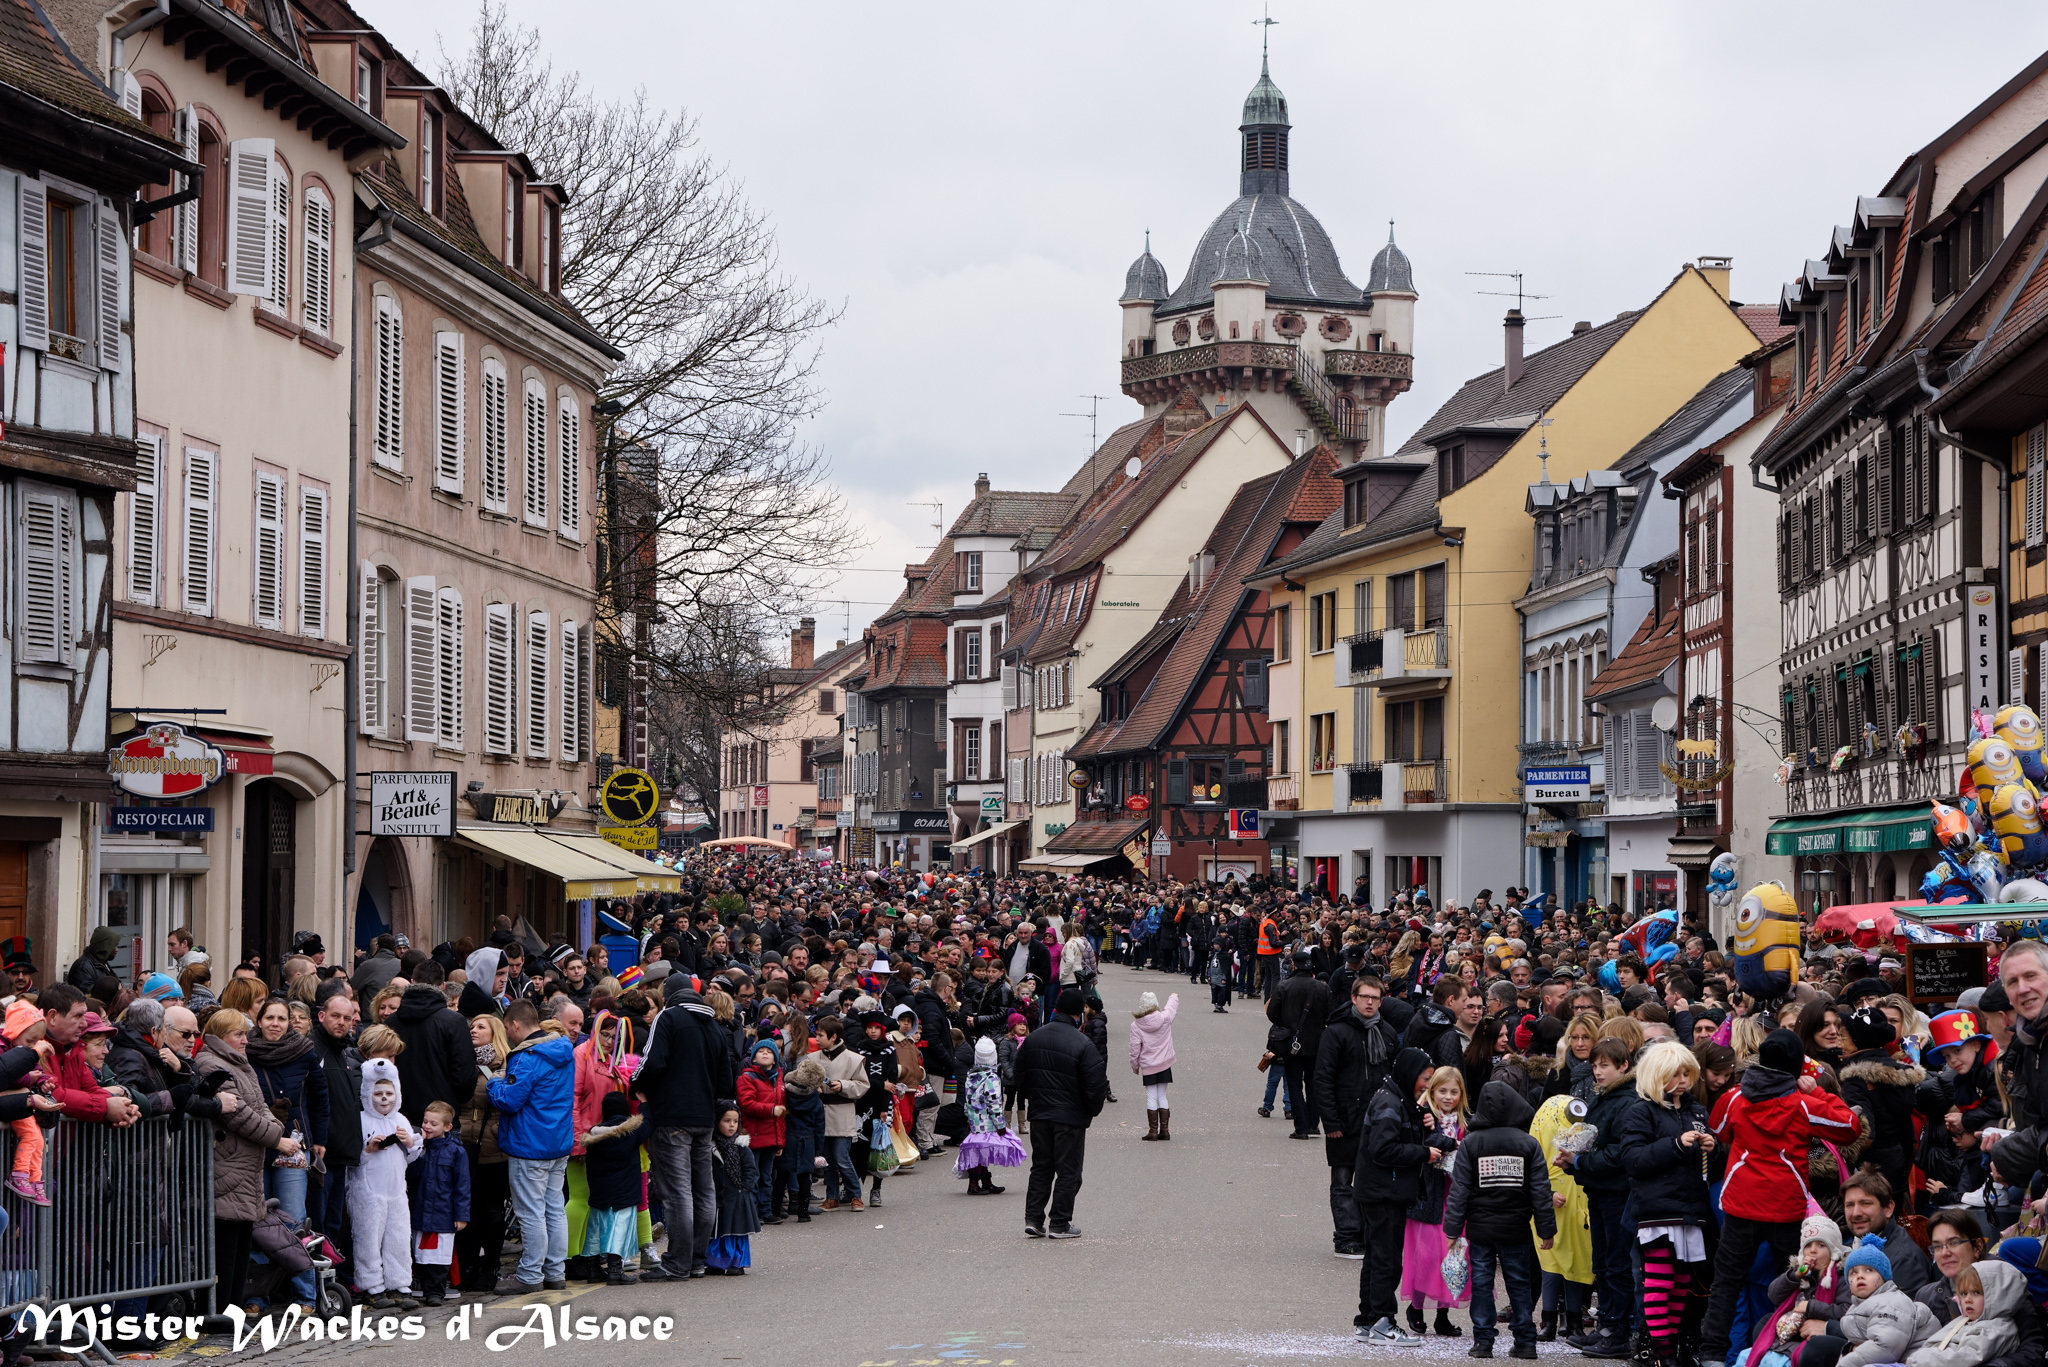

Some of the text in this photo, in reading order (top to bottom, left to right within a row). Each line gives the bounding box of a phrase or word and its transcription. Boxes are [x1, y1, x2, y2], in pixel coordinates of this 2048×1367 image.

[110, 750, 217, 780] Kronenbourg
[373, 775, 450, 784] PARFUMERIE
[1526, 770, 1588, 780] PARMENTIER
[389, 788, 427, 806] Art &
[1535, 789, 1580, 798] Bureau
[381, 797, 441, 821] Beauté
[117, 813, 205, 826] RESTO'ECLAIR
[383, 824, 440, 834] INSTITUT
